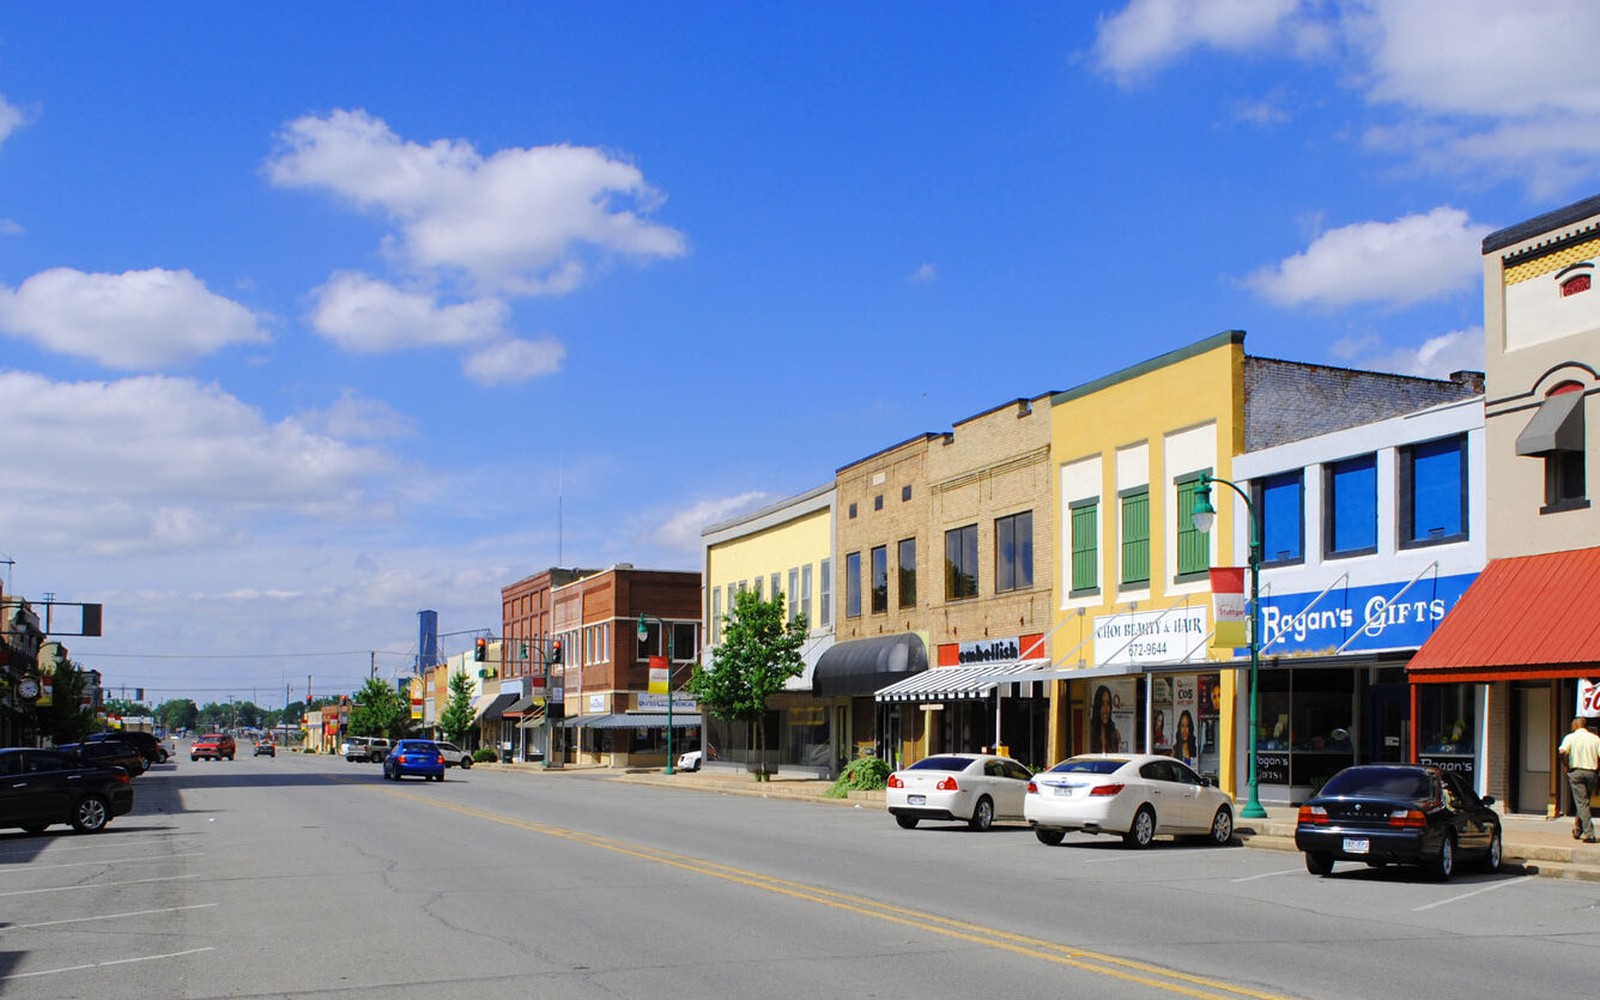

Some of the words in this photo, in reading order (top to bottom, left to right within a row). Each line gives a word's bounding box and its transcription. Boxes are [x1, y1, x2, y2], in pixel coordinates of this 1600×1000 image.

[1174, 618, 1202, 634] HAIR
[1261, 606, 1352, 643] Ragan's
[1364, 595, 1445, 637] GIFTS
[959, 641, 1018, 663] embellish
[1128, 642, 1167, 656] 672-9644
[1257, 755, 1288, 768] agan's
